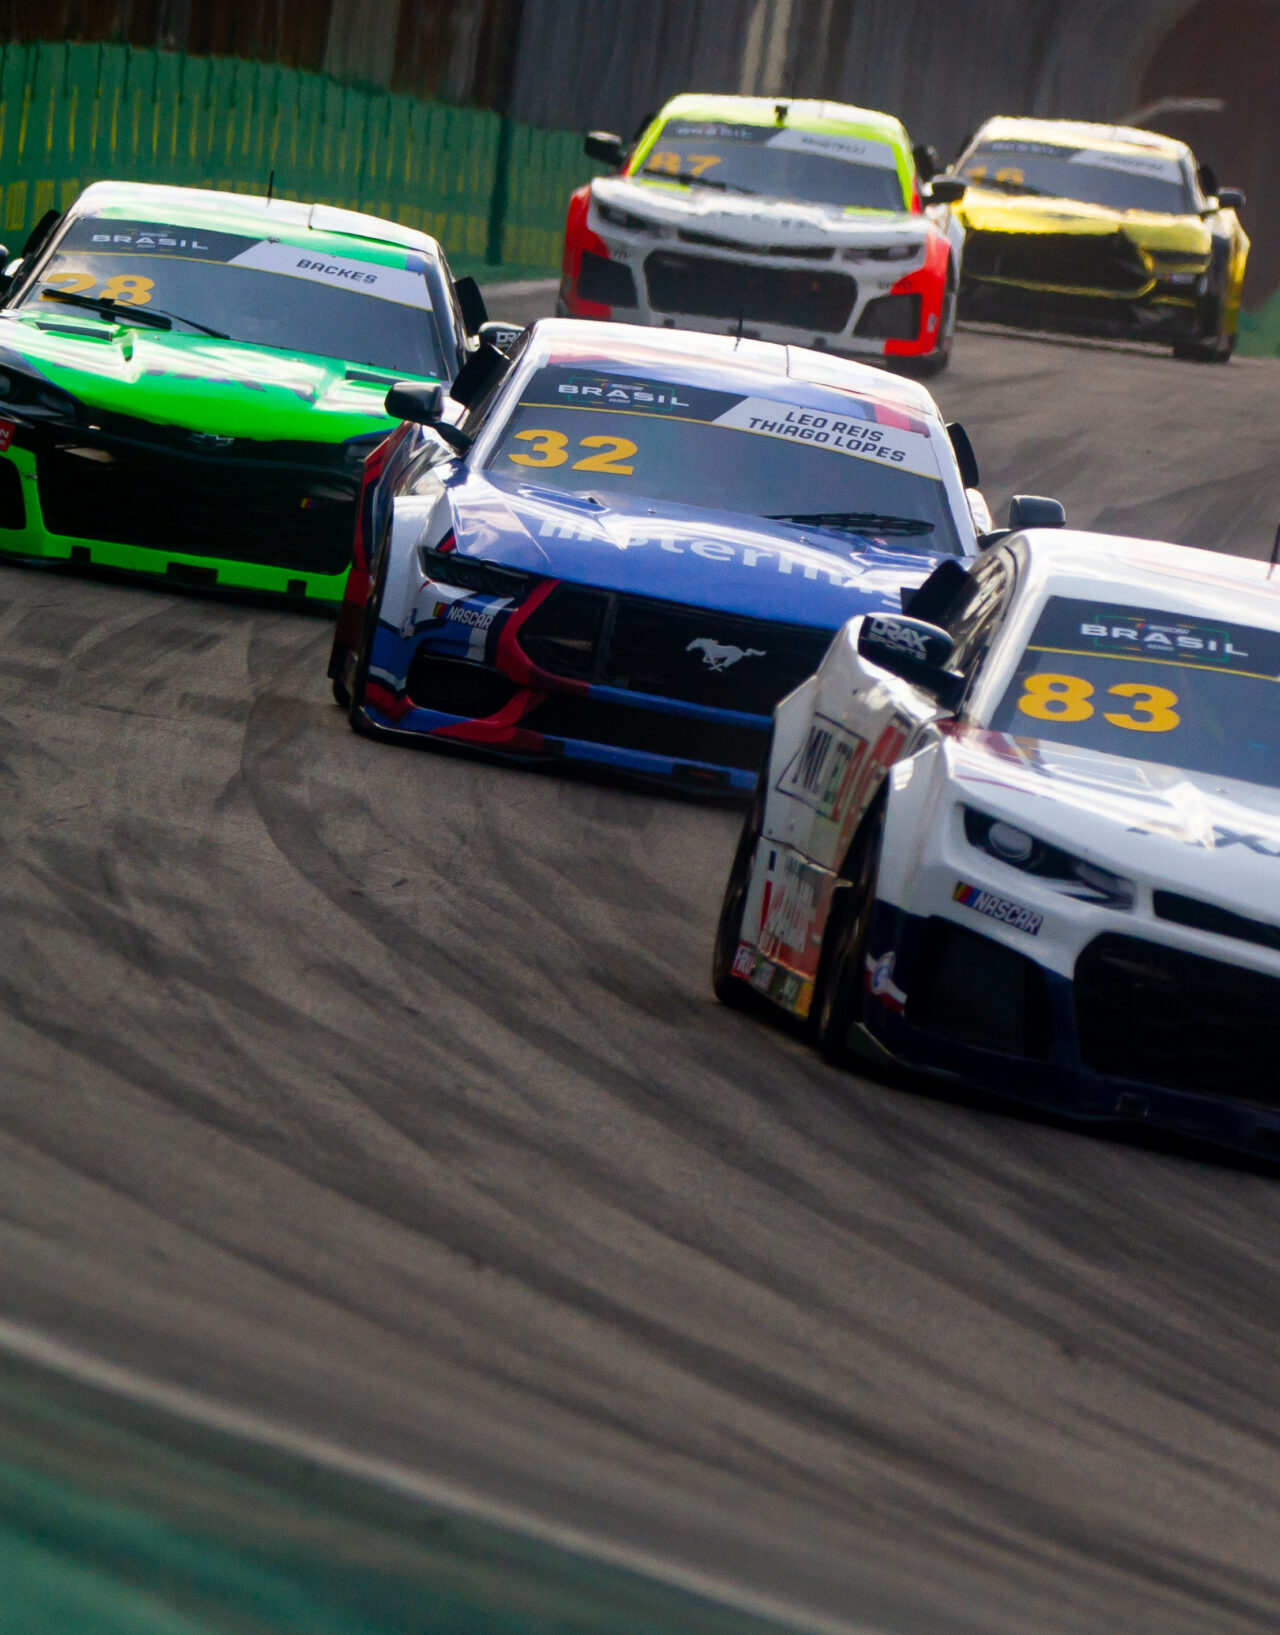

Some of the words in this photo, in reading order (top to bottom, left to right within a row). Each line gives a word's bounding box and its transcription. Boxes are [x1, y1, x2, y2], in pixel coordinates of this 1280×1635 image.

[92, 234, 209, 250] BRASIL
[296, 258, 379, 284] BACKES
[39, 273, 155, 307] 28
[558, 384, 690, 407] BRASIL
[749, 417, 830, 443] THIAGO
[834, 436, 906, 463] LOPES
[785, 411, 828, 429] LEO
[831, 421, 884, 442] REIS
[508, 429, 638, 475] 32
[447, 606, 494, 630] NASCAR
[870, 619, 932, 653] DRAX
[1081, 623, 1249, 657] BRASIL
[1018, 673, 1181, 732] 83
[973, 892, 1044, 935] NASCAR
